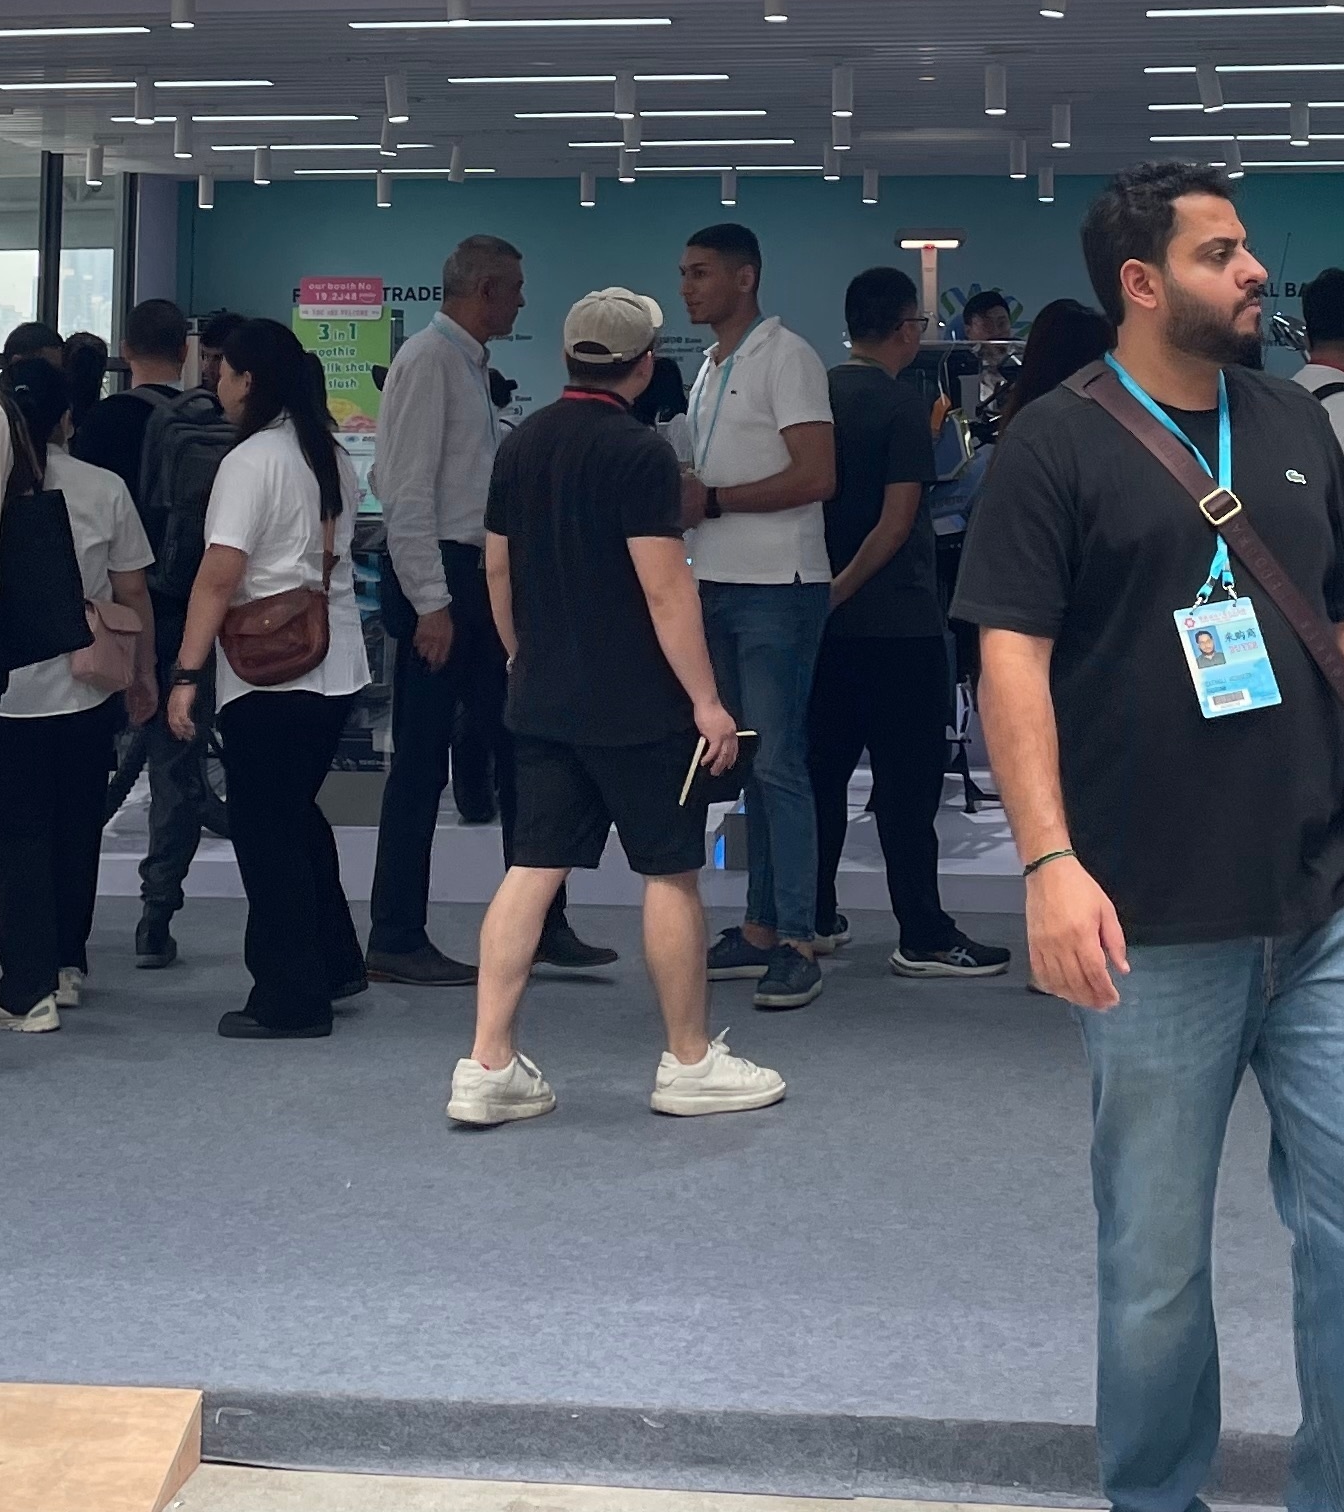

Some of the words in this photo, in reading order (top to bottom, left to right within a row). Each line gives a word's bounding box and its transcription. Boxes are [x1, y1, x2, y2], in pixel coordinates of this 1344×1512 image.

[382, 287, 442, 302] TRADE
[318, 324, 330, 340] 3
[334, 330, 346, 341] in
[349, 323, 357, 340] 1
[307, 346, 356, 357] moothie
[345, 361, 373, 373] shak
